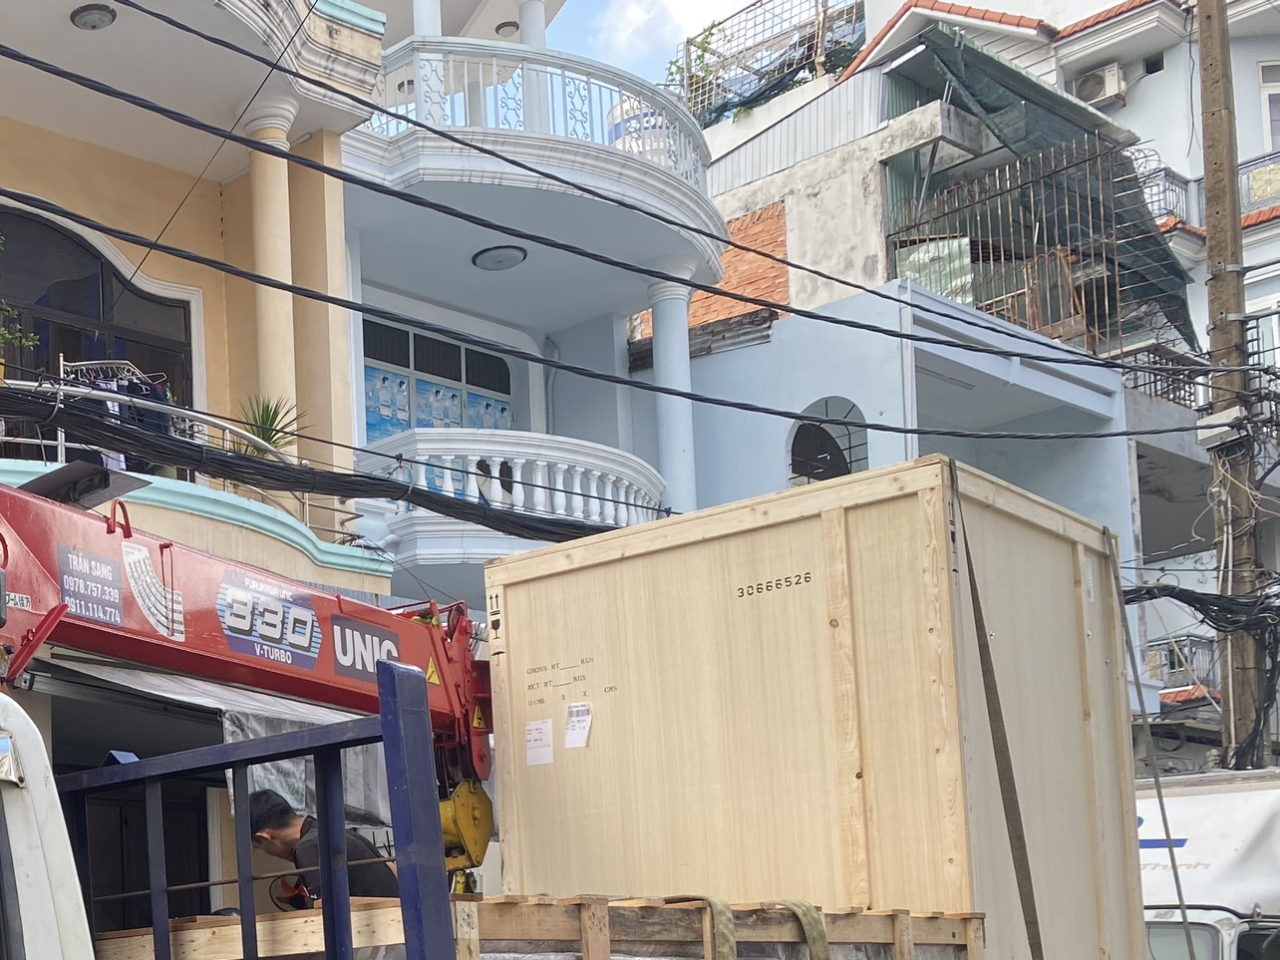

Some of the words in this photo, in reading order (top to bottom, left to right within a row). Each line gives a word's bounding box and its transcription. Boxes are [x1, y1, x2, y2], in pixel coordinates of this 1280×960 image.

[91, 560, 113, 581] SANG
[63, 574, 120, 604] 0978.757.339
[736, 571, 814, 599] 30666526
[64, 596, 122, 624] 0911.114.774
[225, 586, 315, 651] 330
[253, 642, 293, 665] V-TURBO
